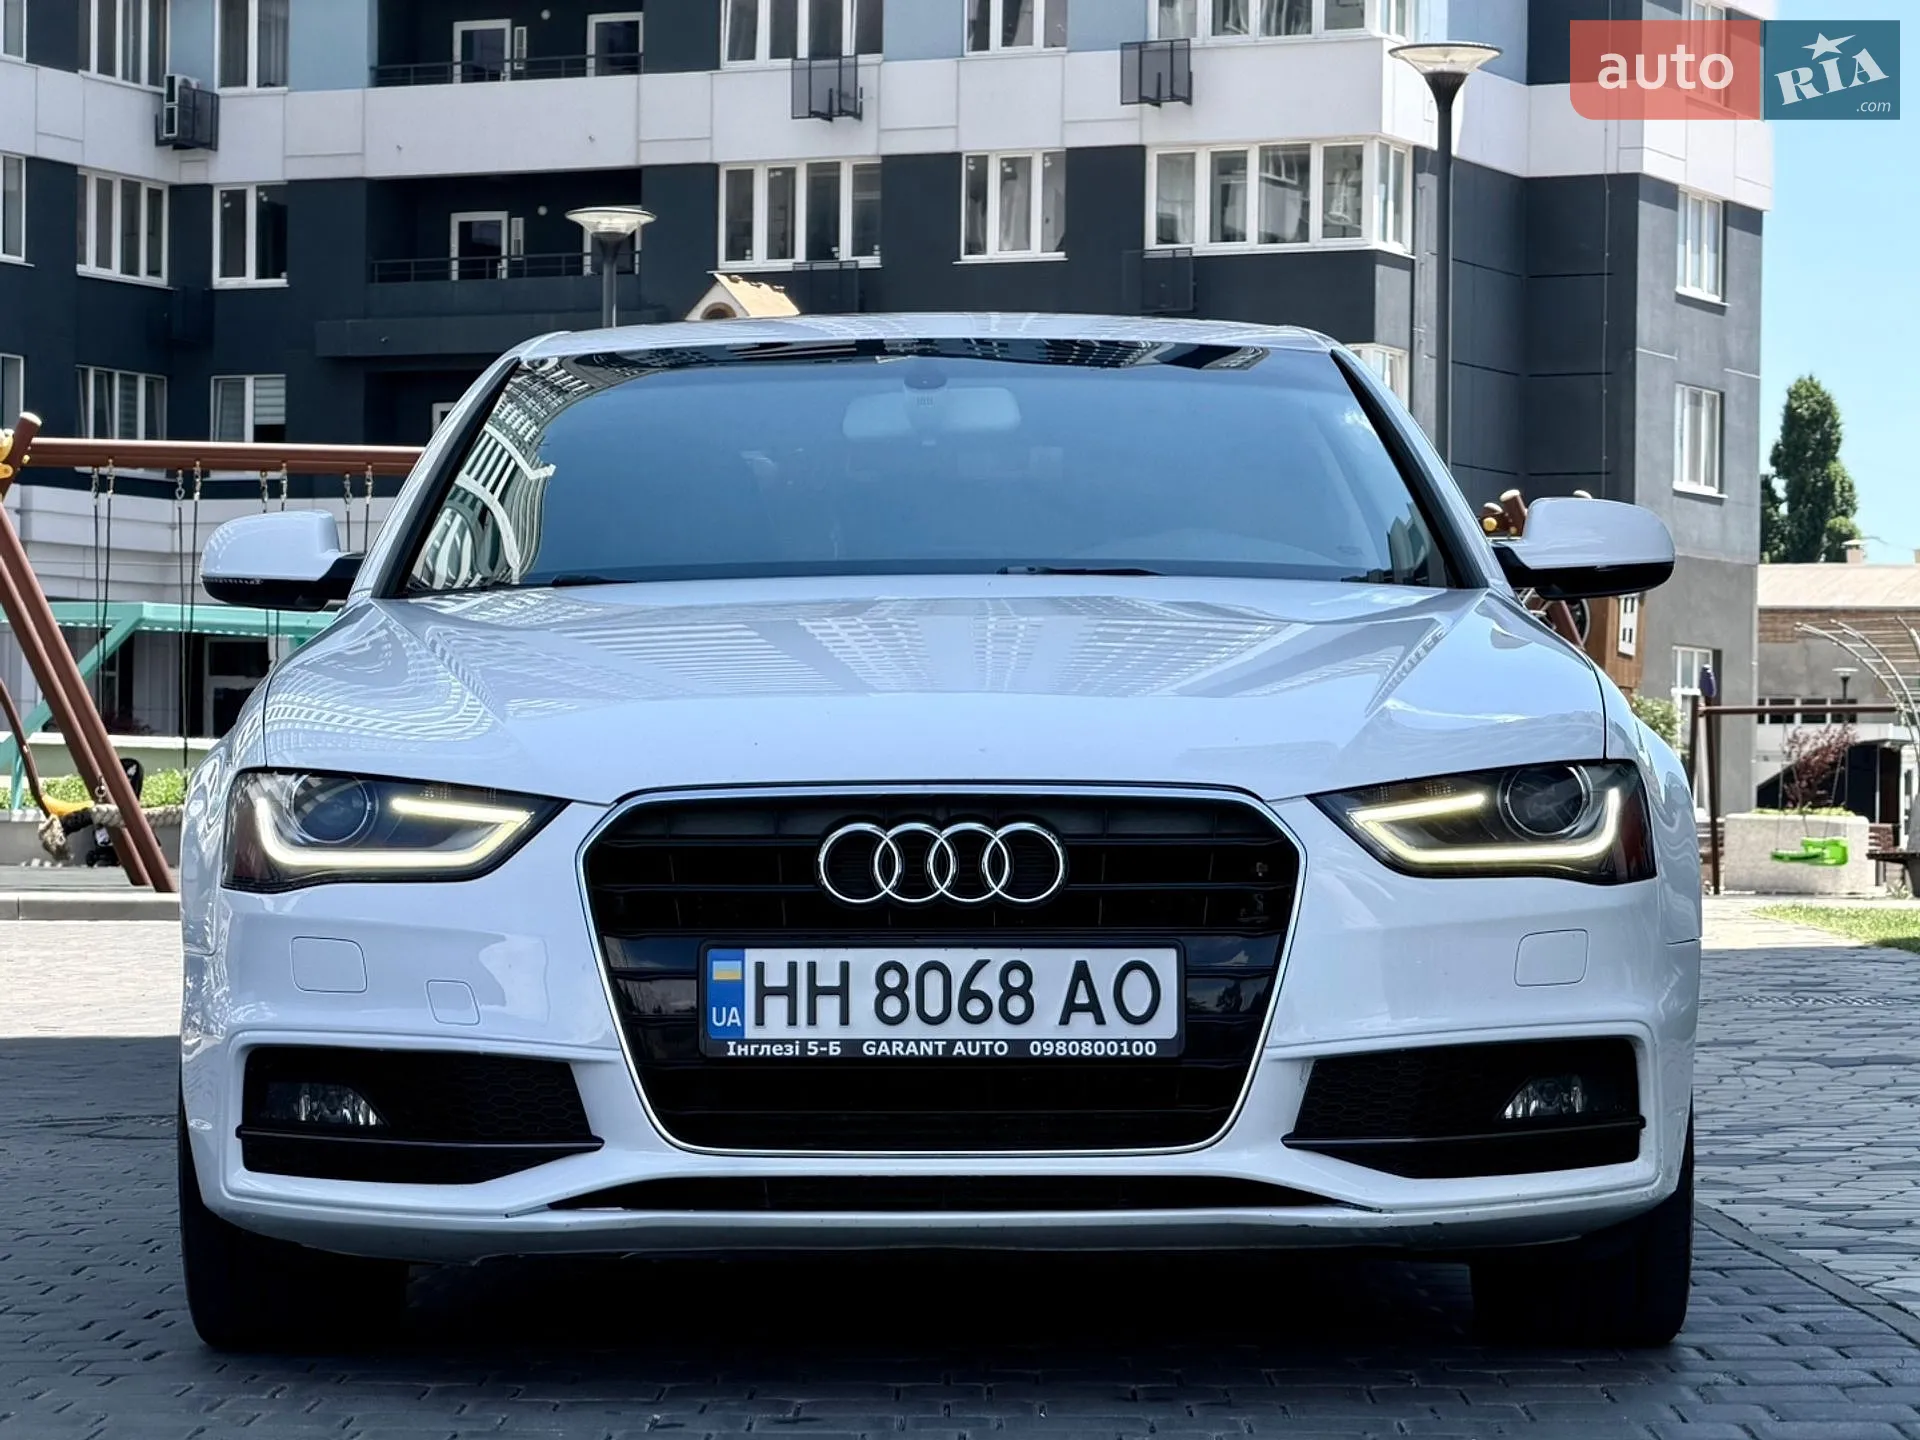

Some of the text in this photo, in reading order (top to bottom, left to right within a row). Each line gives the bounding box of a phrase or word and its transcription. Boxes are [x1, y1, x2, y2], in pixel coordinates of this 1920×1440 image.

[753, 959, 1162, 1026] HH 8068 AO
[711, 1007, 742, 1027] UA
[726, 1040, 1157, 1056] Інглезі 5-Б GARANT AUTO 0980800100
